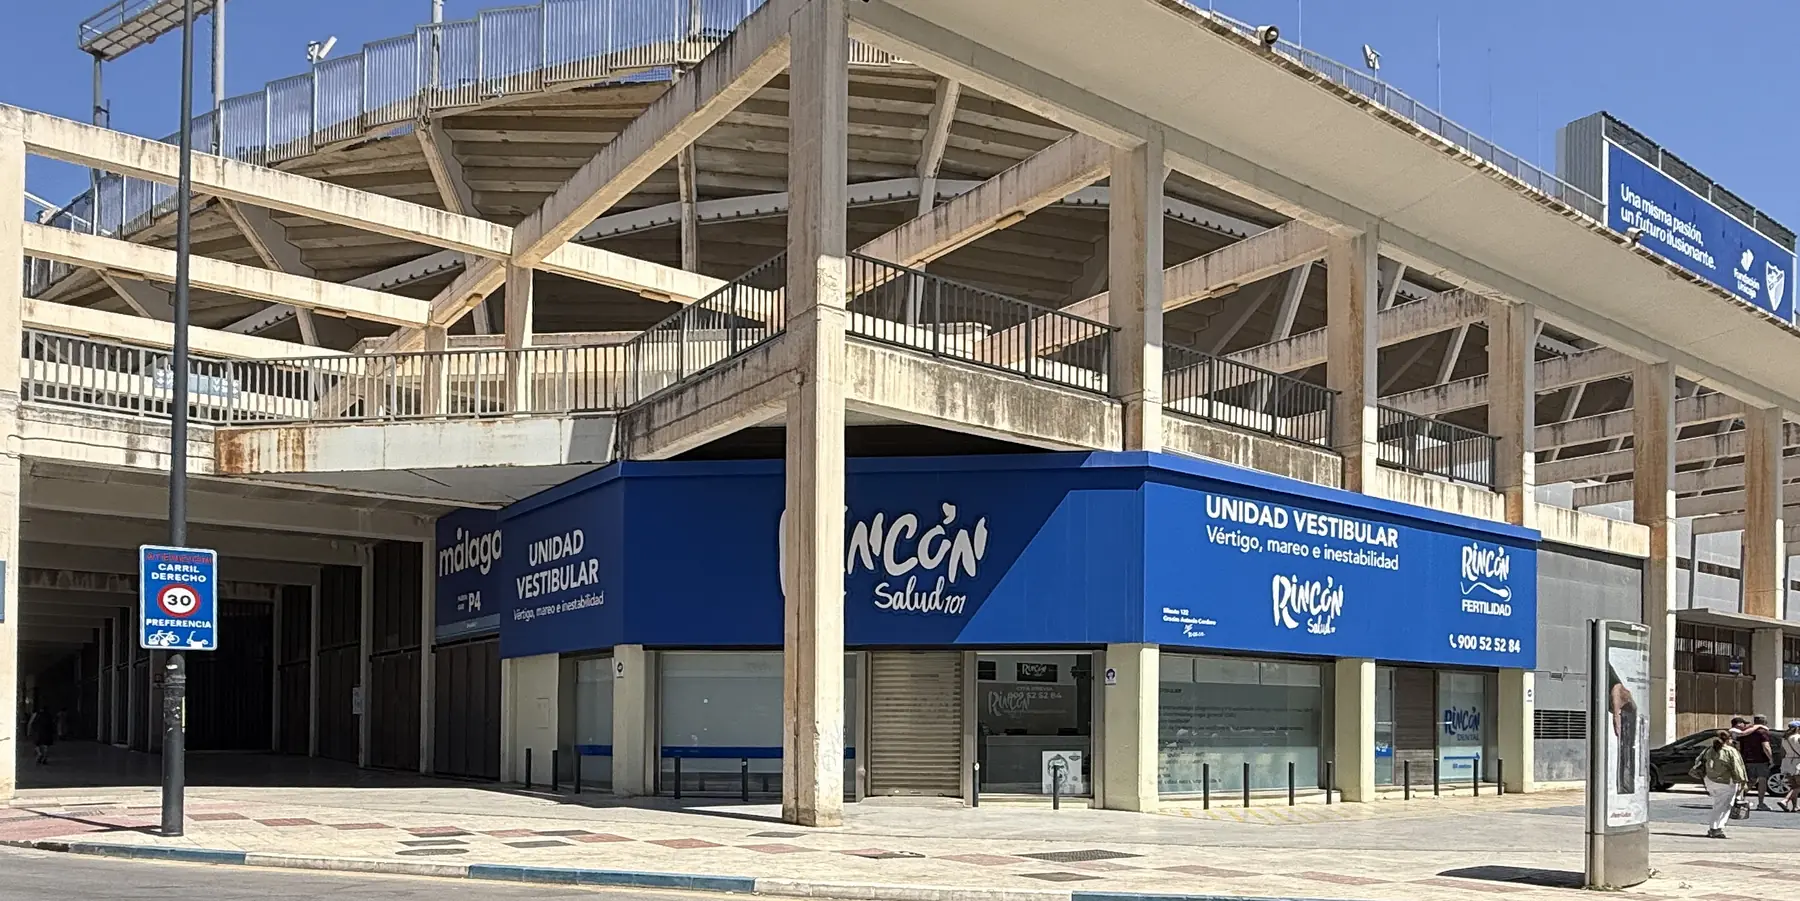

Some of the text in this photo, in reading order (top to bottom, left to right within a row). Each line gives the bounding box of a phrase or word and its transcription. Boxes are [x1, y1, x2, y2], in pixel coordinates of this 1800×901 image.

[1621, 183, 1704, 247] Una misma pasión,
[1621, 207, 1717, 270] un futuro ilusionante.
[1206, 495, 1399, 548] UNIDAD VESTIBULAR
[529, 529, 584, 567] UNIDAD
[1206, 525, 1399, 571] Vértigo, mareo e inestabilidad
[151, 572, 207, 583] DERECHO
[158, 563, 200, 573] CARRIL
[516, 558, 599, 600] VESTIBULAR
[167, 594, 192, 606] 30
[468, 591, 481, 612] P4
[536, 604, 555, 617] mareo
[556, 603, 561, 613] e
[561, 590, 604, 612] inestabilidad
[874, 575, 945, 612] Salud
[1462, 599, 1511, 617] FERTILIDAD
[146, 618, 212, 629] PREFERENCIA
[1458, 635, 1521, 653] 900 52 52 84
